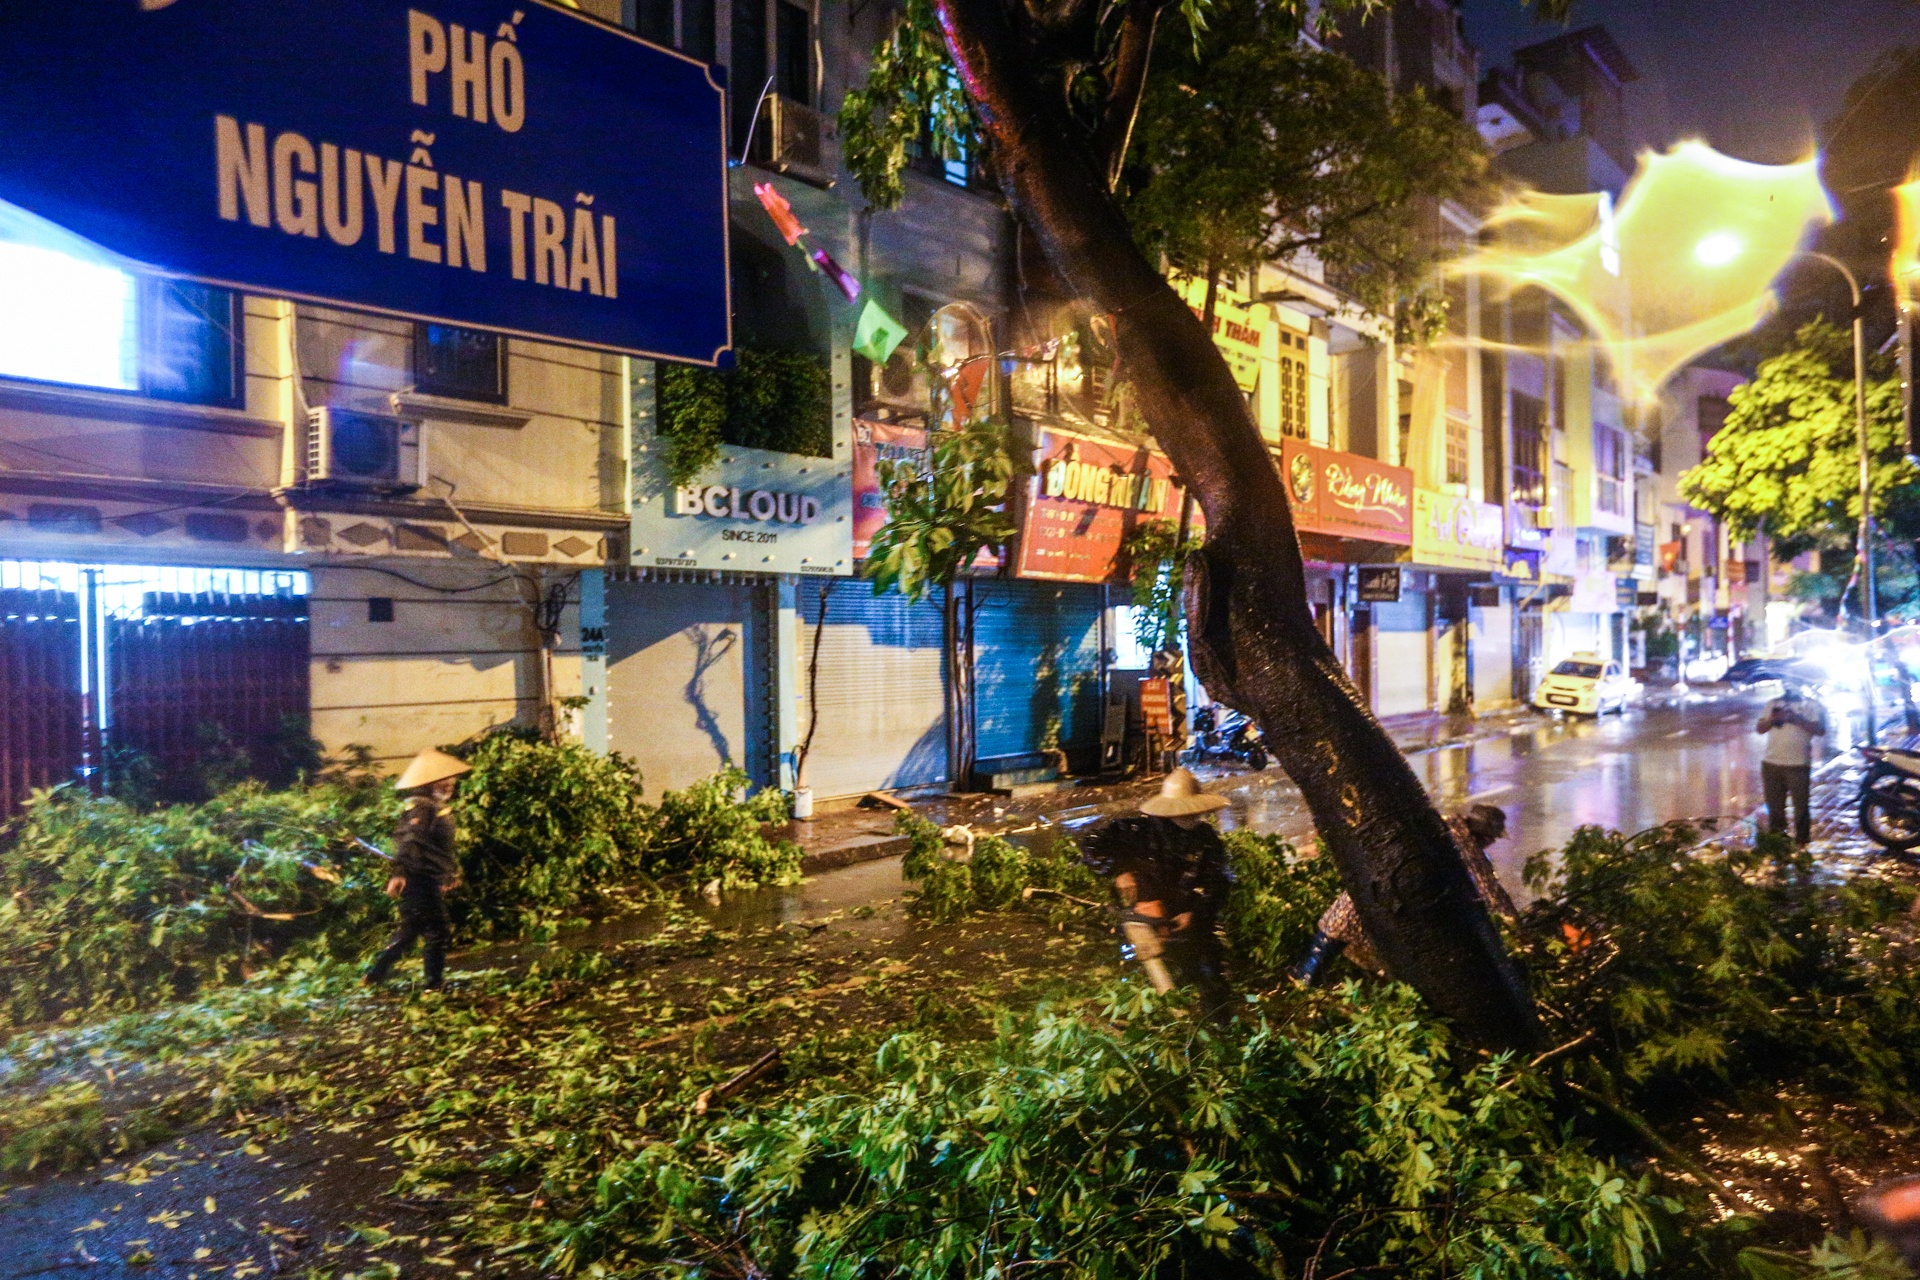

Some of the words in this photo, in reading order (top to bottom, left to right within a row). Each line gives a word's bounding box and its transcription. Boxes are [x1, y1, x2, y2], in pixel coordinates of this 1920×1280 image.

[408, 8, 526, 133] PHỐ
[214, 113, 487, 273] NGUYỄN
[502, 189, 618, 299] TRÃI
[677, 483, 822, 525] BCLOUD
[721, 528, 755, 543] SINCE
[756, 530, 778, 544] 2011
